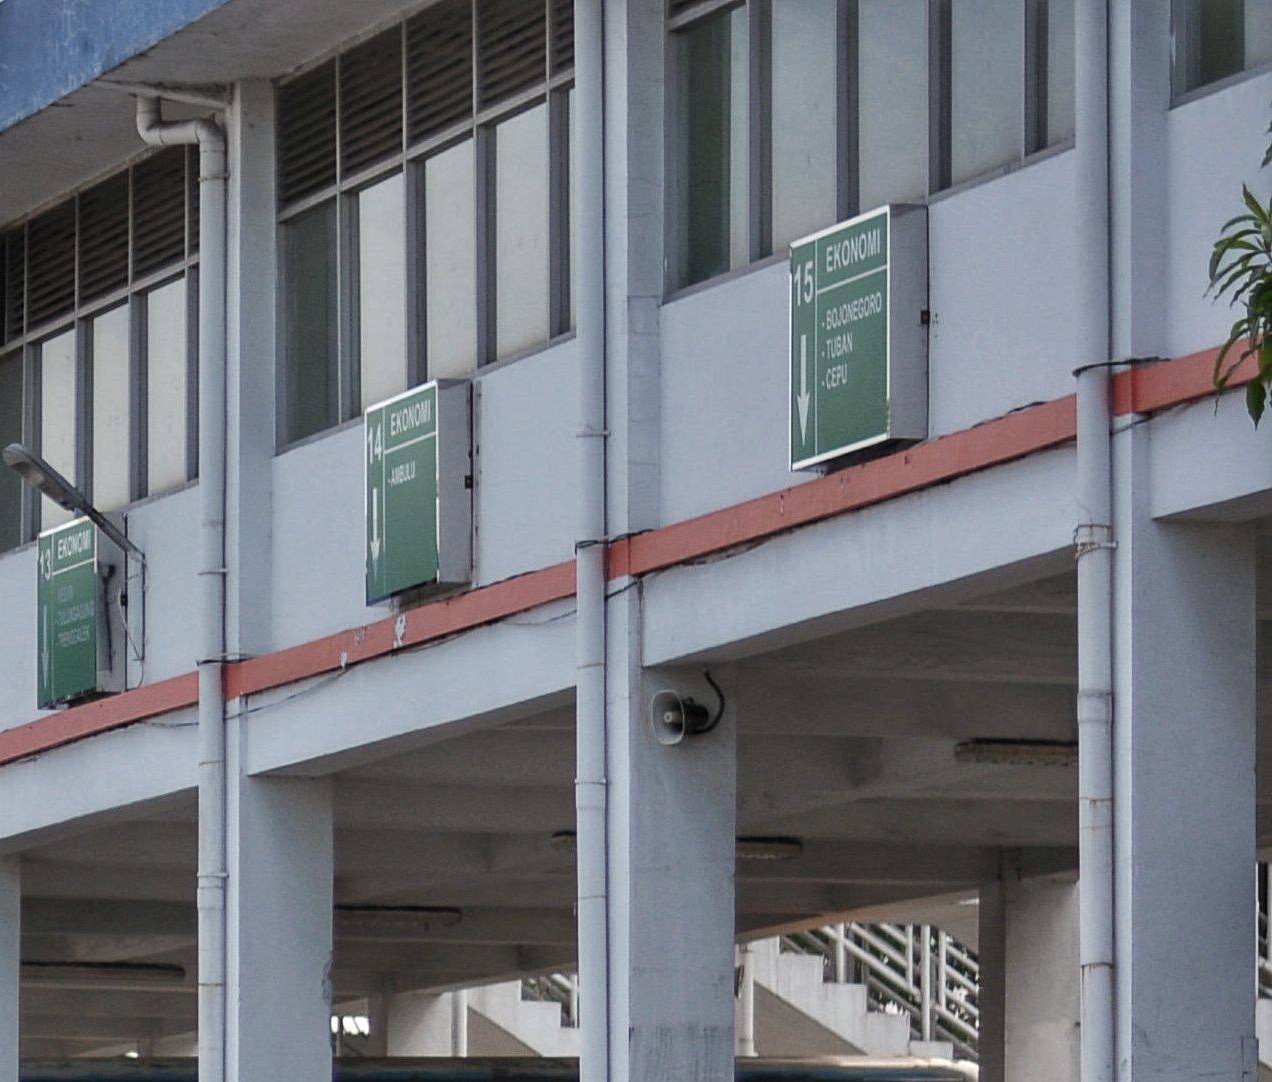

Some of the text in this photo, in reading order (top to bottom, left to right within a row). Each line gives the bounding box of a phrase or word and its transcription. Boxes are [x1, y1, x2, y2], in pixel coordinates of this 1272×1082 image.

[794, 227, 881, 308] 15 EKONOMI
[367, 398, 432, 464] 14 EKONOMI
[40, 529, 91, 581] 13 EKONOMI
